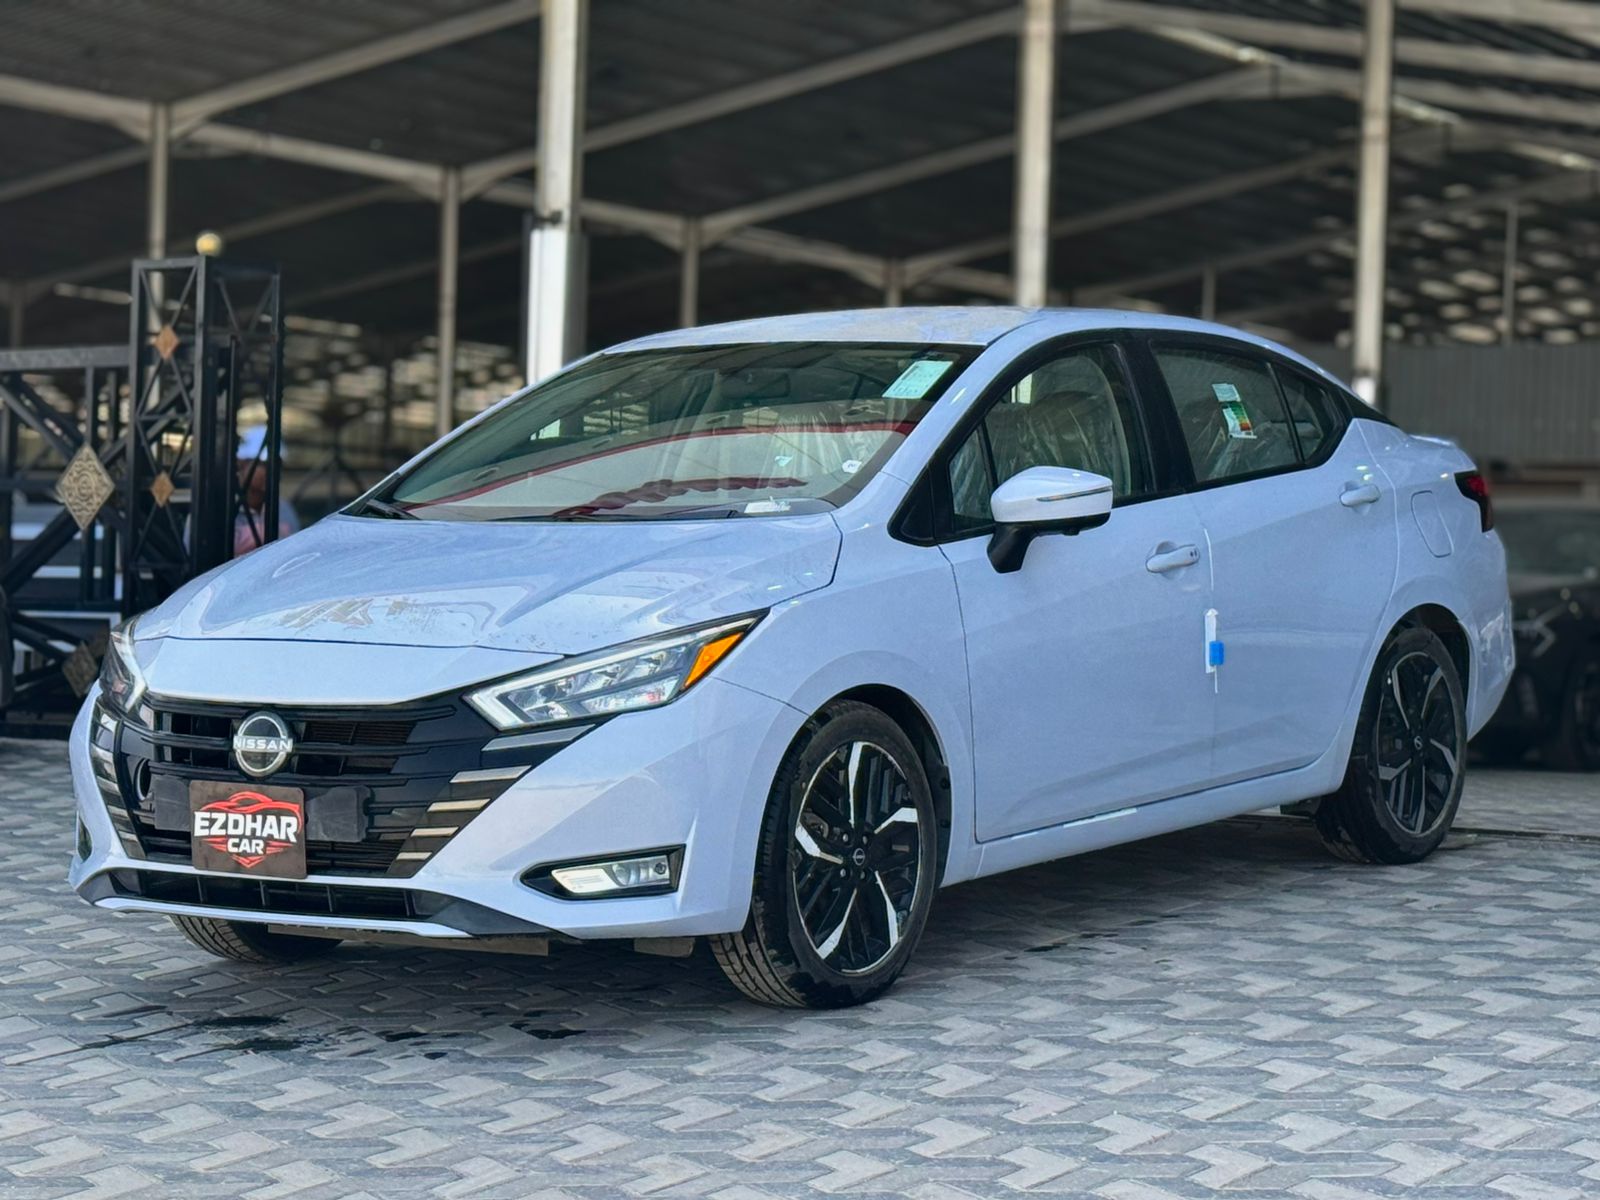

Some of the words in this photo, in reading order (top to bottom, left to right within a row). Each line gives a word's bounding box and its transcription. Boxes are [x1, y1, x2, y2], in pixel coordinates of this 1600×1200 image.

[234, 738, 291, 750] NISSAN
[194, 811, 297, 843] EZDHAR
[227, 838, 264, 855] CAR
